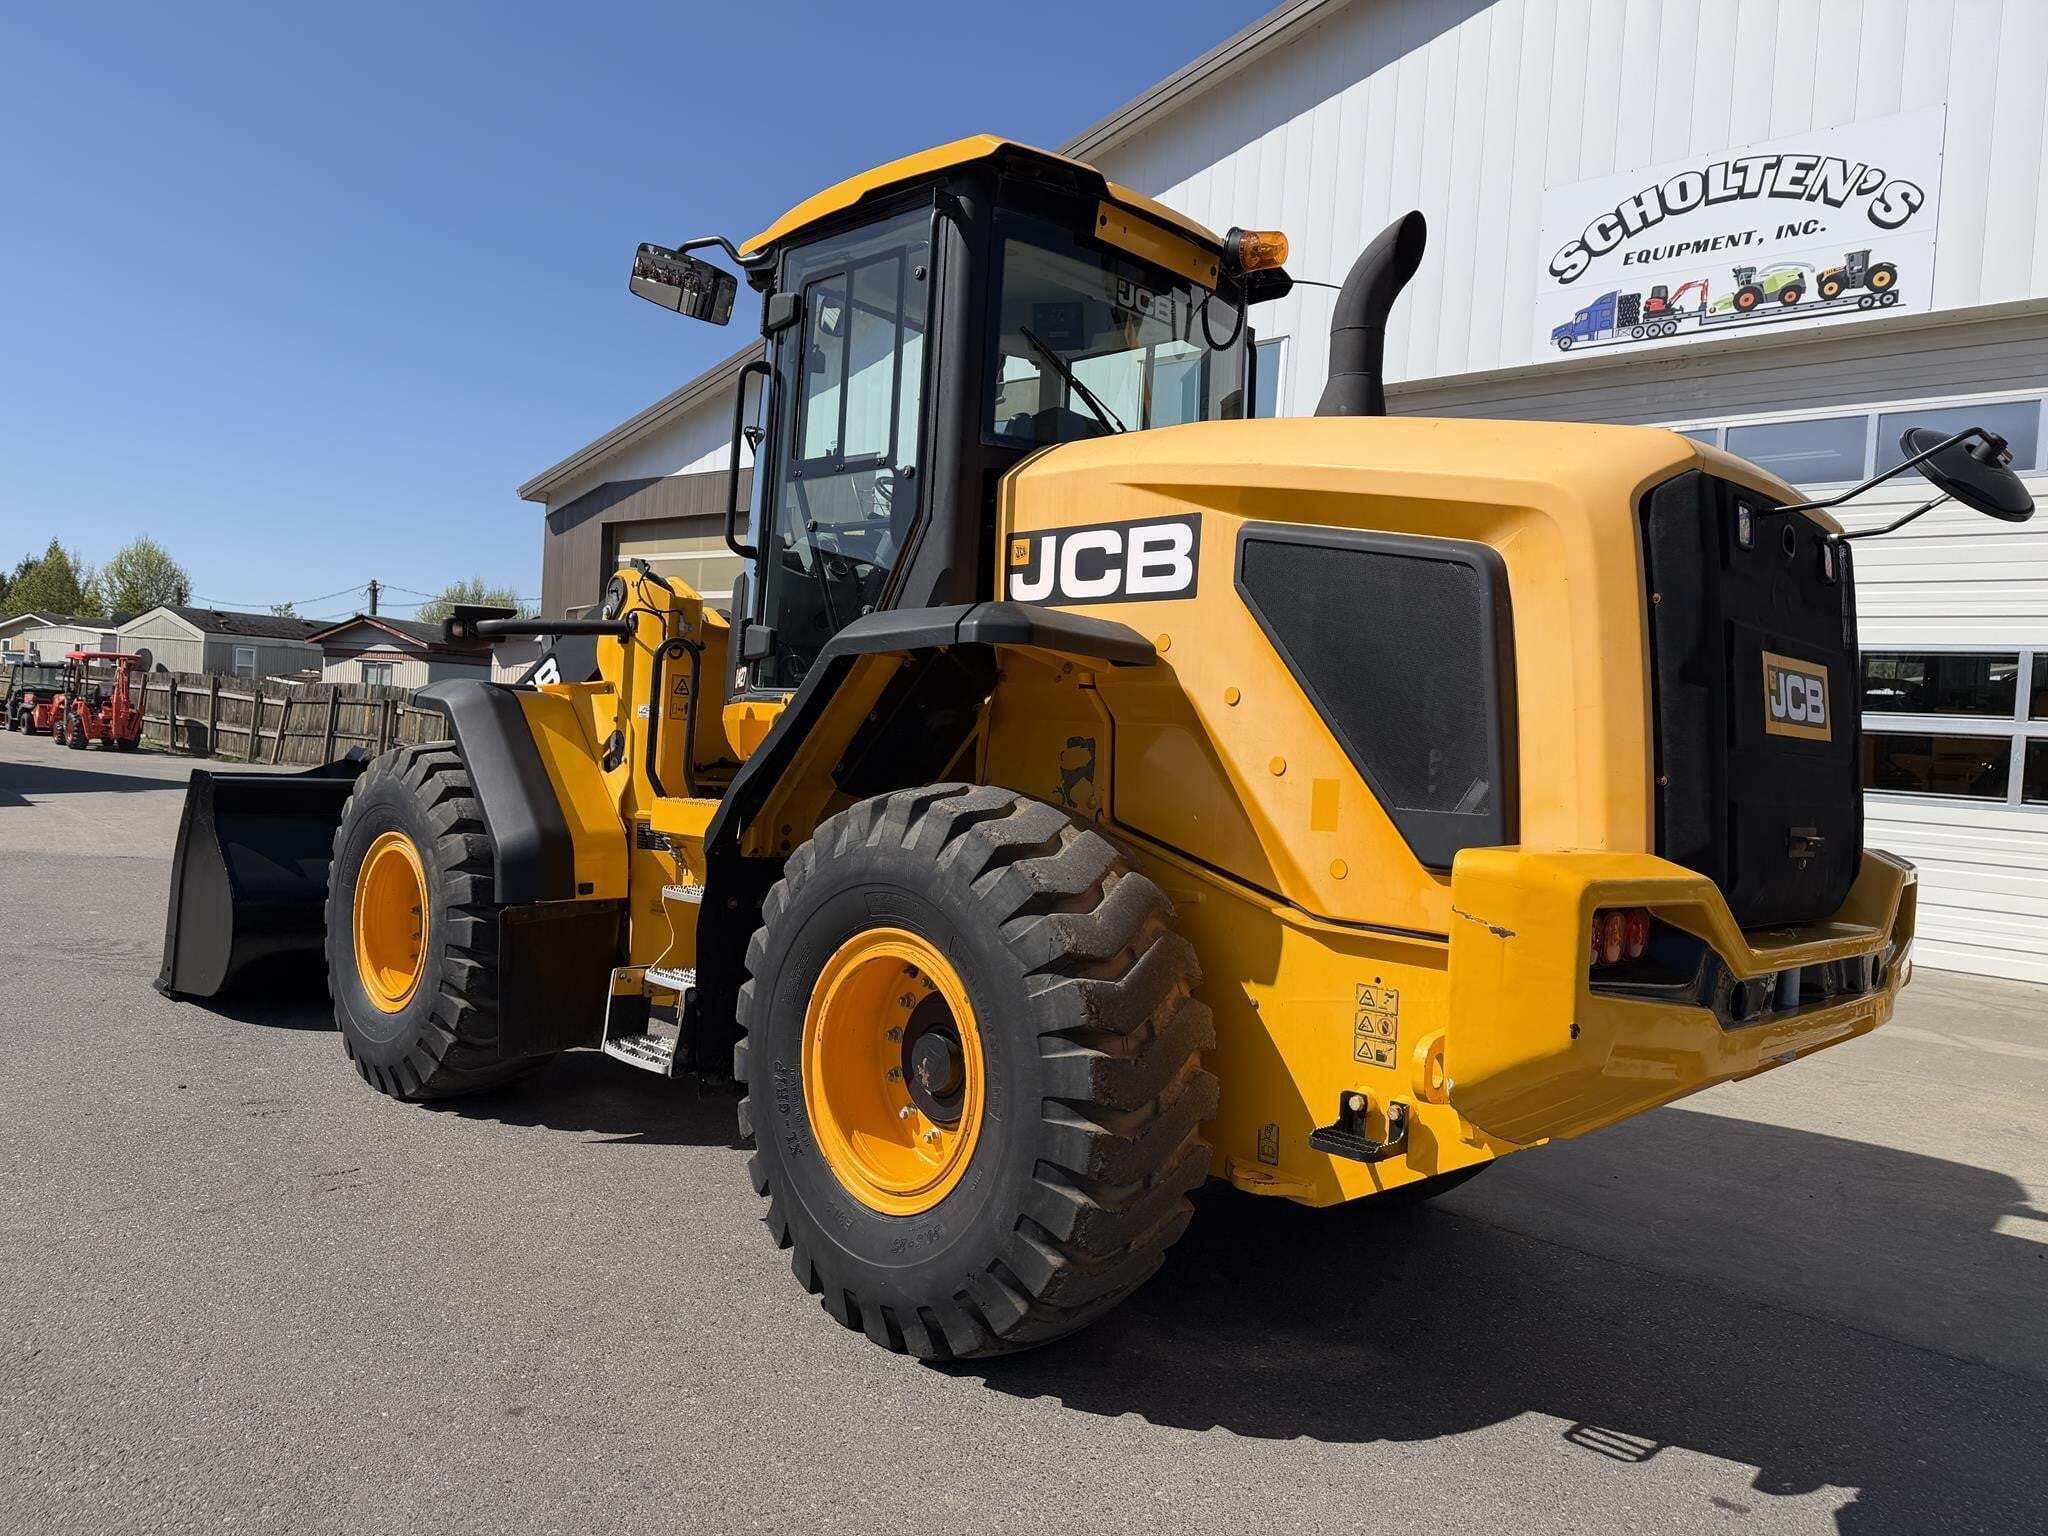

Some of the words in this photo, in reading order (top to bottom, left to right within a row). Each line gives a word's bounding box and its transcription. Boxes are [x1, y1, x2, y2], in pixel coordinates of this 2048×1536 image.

[1549, 154, 1924, 285] SCHOLTEN'S
[1623, 230, 1764, 266] EQUIPMENT,
[1775, 219, 1826, 240] INC.
[1118, 283, 1171, 323] JCB
[1010, 523, 1193, 601] JCB
[1770, 672, 1825, 723] JCB
